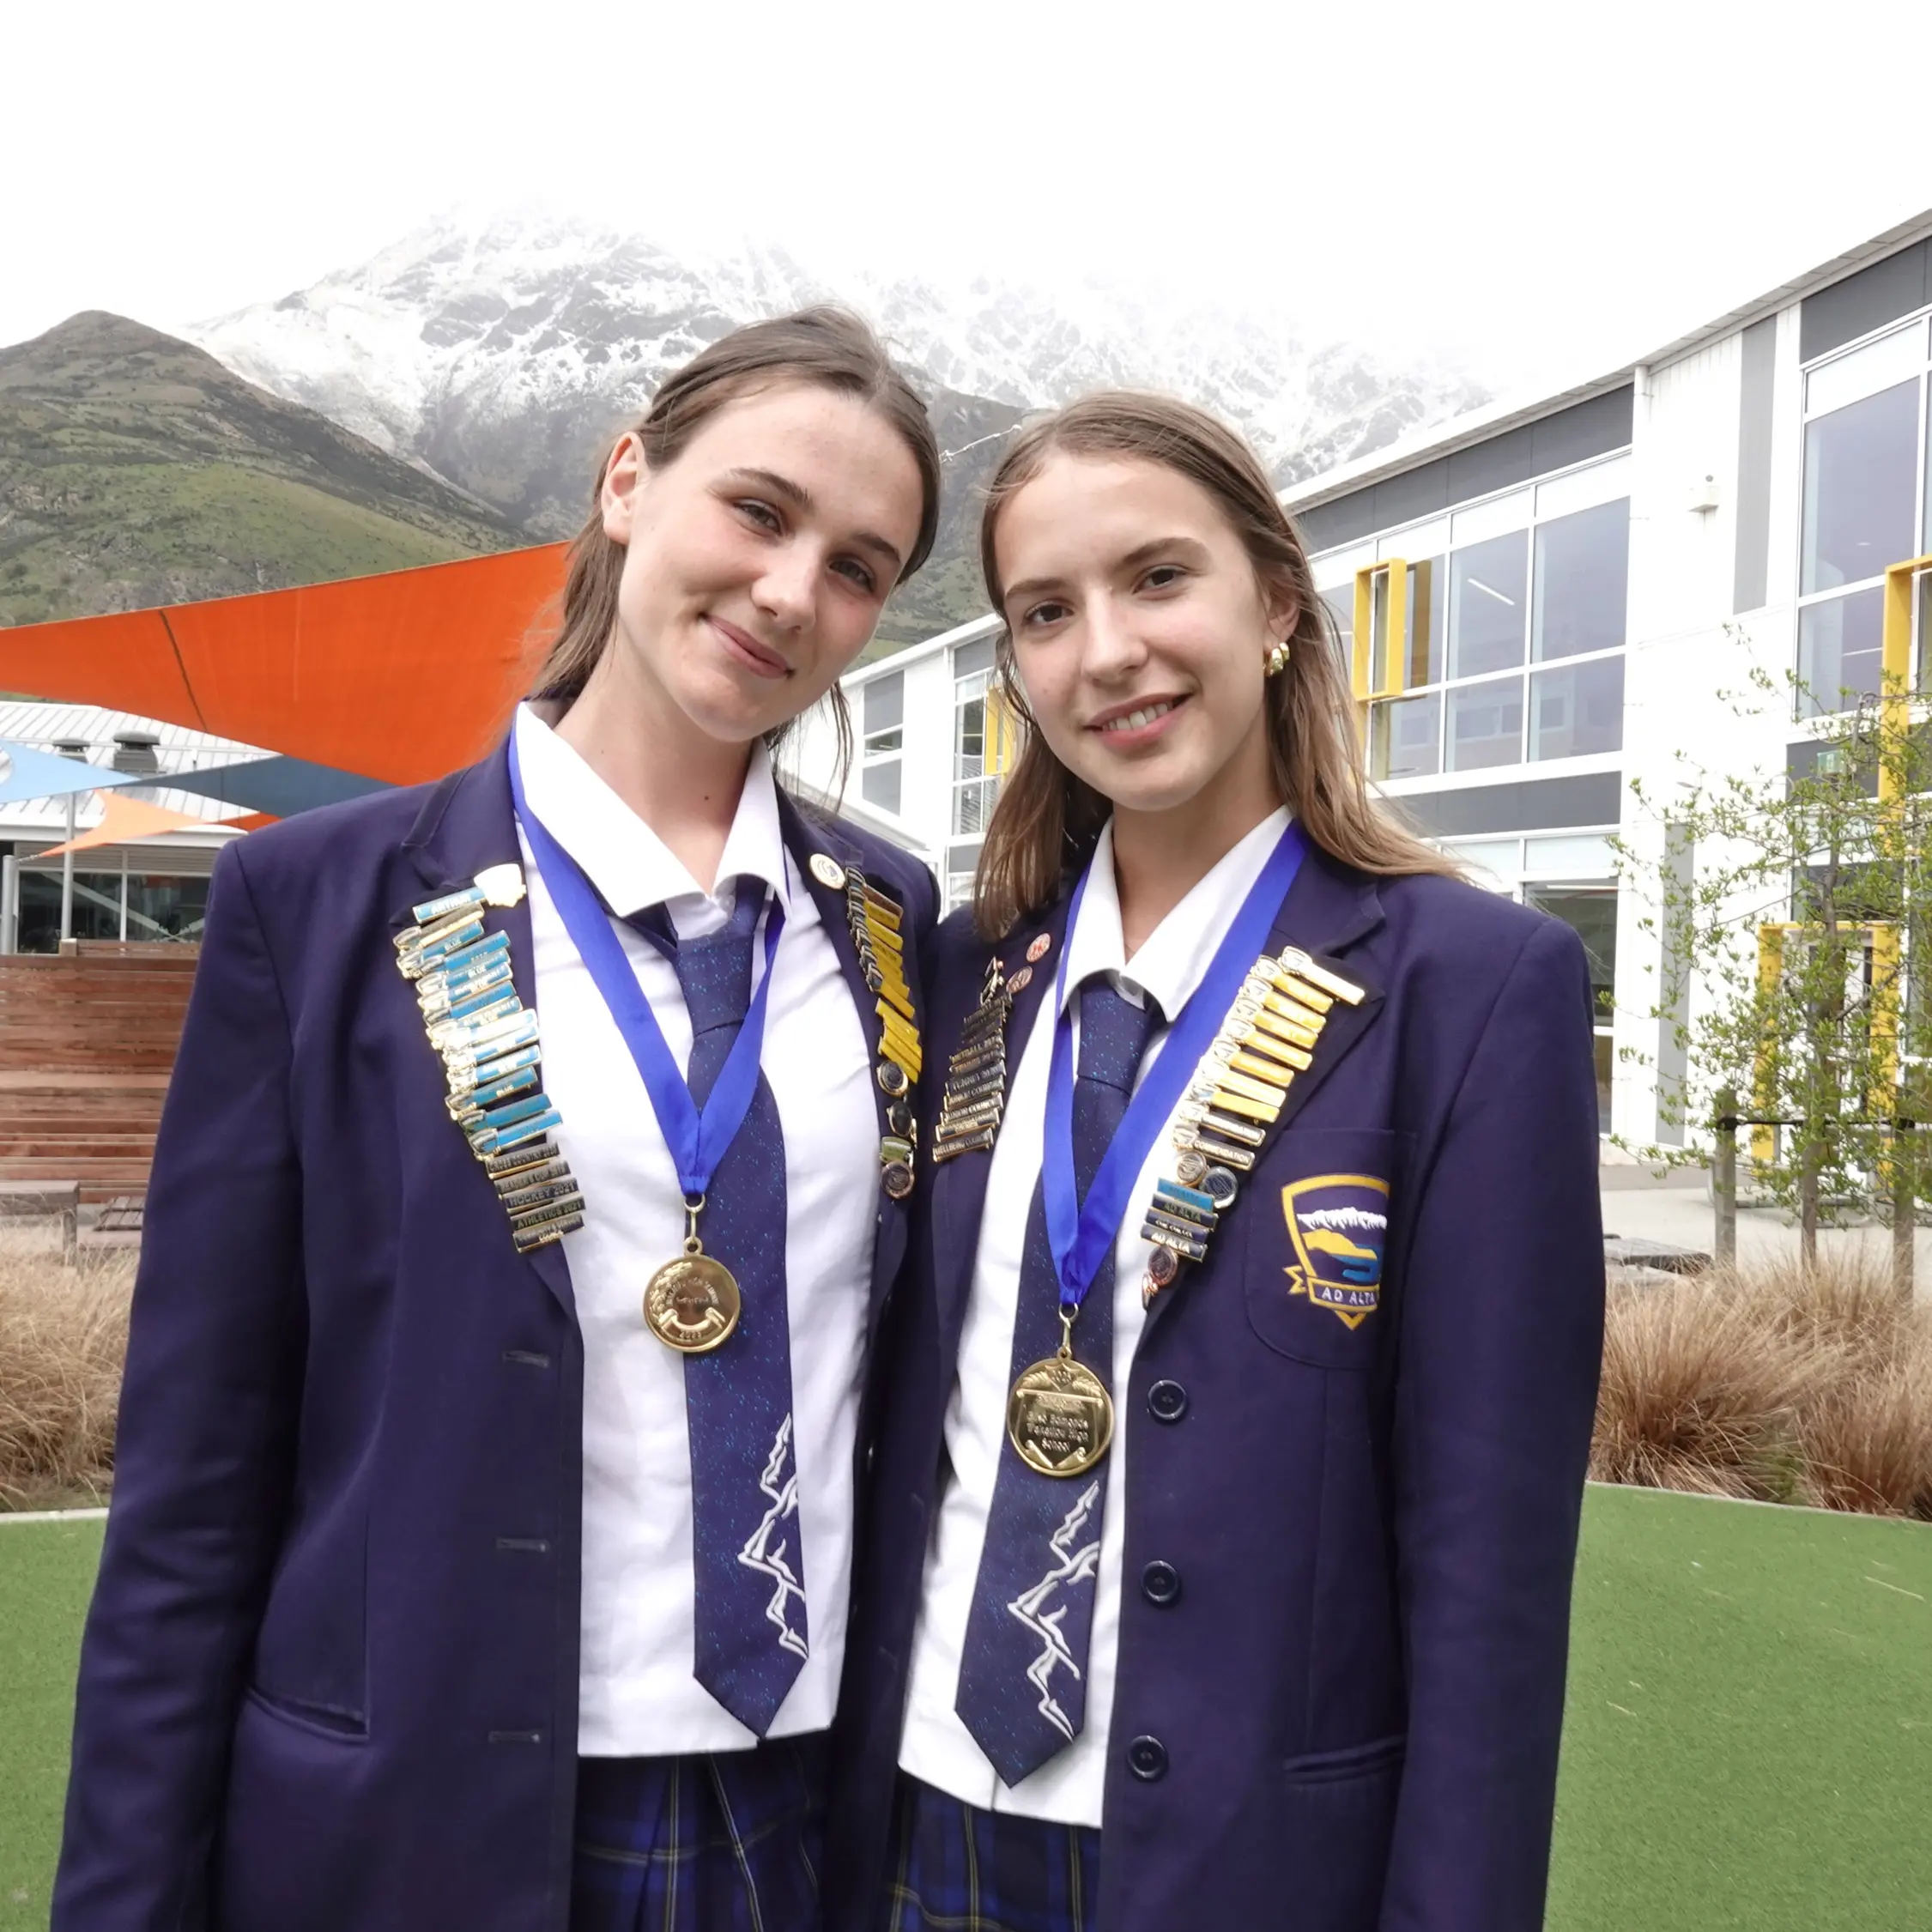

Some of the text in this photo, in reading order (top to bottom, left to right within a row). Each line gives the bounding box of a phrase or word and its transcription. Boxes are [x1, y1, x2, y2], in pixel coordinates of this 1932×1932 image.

[510, 1179, 575, 1207] HOCKEY 2021
[517, 1200, 581, 1228] ATHLETICS 2021
[1178, 1206, 1202, 1222] ALTA
[1150, 1229, 1192, 1253] AD ALTA
[1321, 1287, 1375, 1305] AD ALTA
